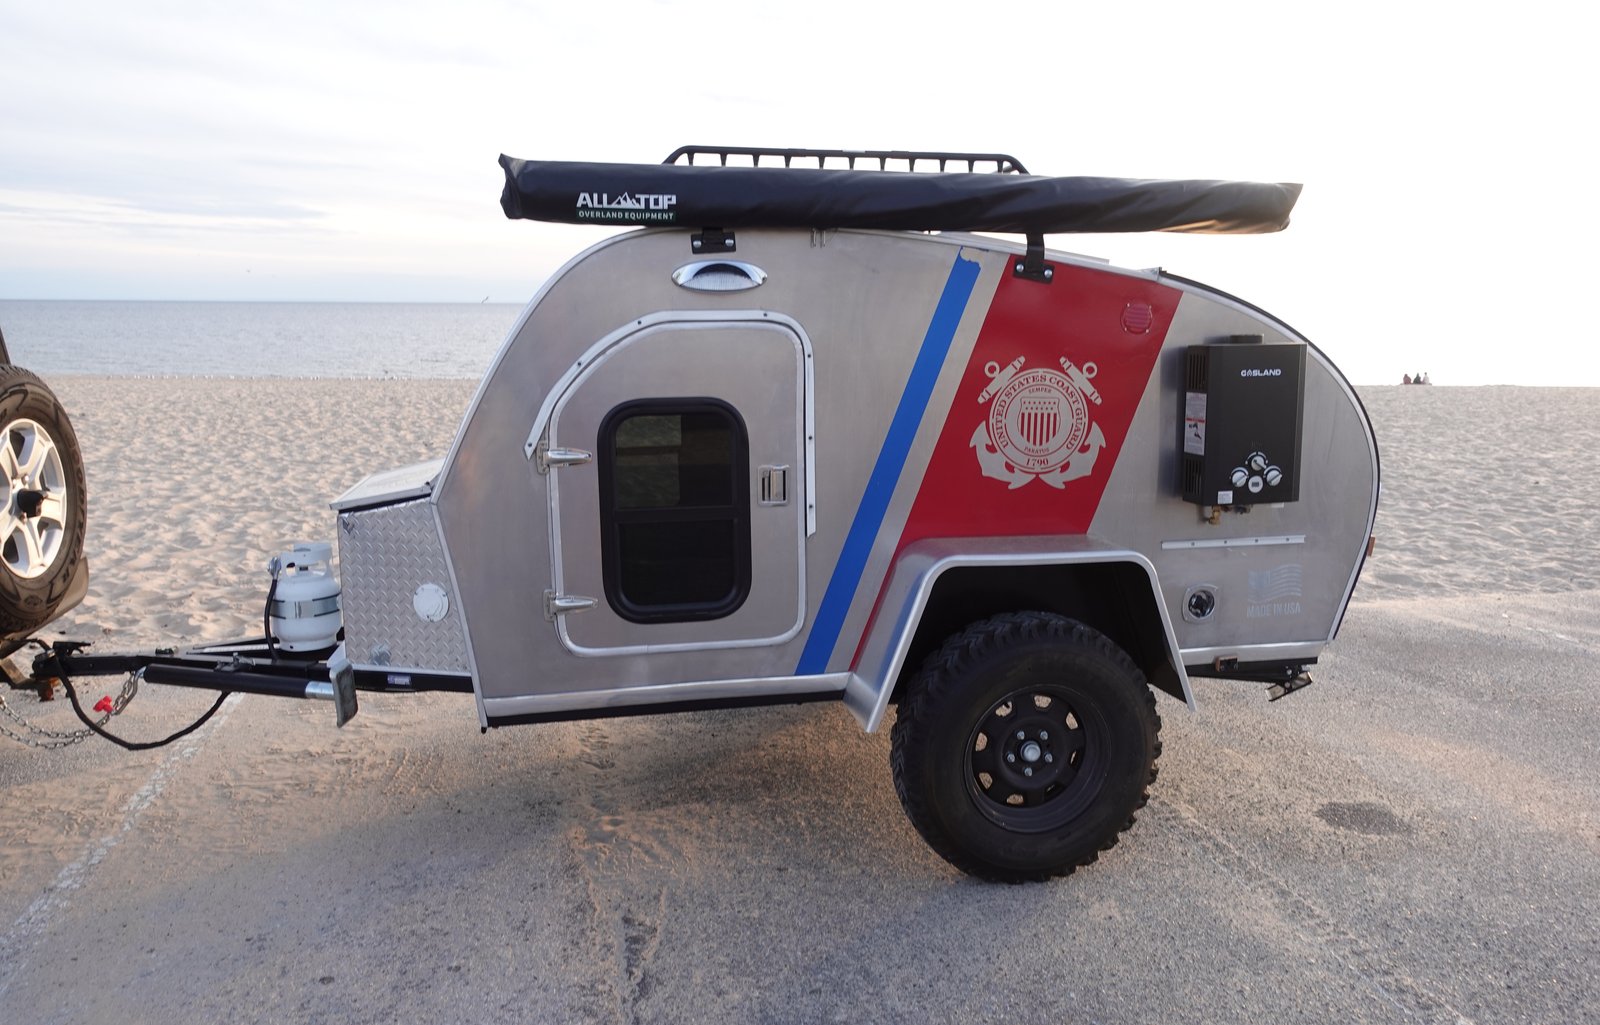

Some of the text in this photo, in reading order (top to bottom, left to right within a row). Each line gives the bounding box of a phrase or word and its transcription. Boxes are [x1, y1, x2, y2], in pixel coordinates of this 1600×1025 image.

[578, 210, 674, 221] OVERLAND EQUIPMENT
[1240, 368, 1282, 377] GASLAND
[994, 374, 1083, 450] UNITED STATES COAST GUARD
[1024, 446, 1050, 455] PARATUS
[1025, 458, 1049, 467] 1790
[1247, 602, 1301, 617] MADE IN USA
